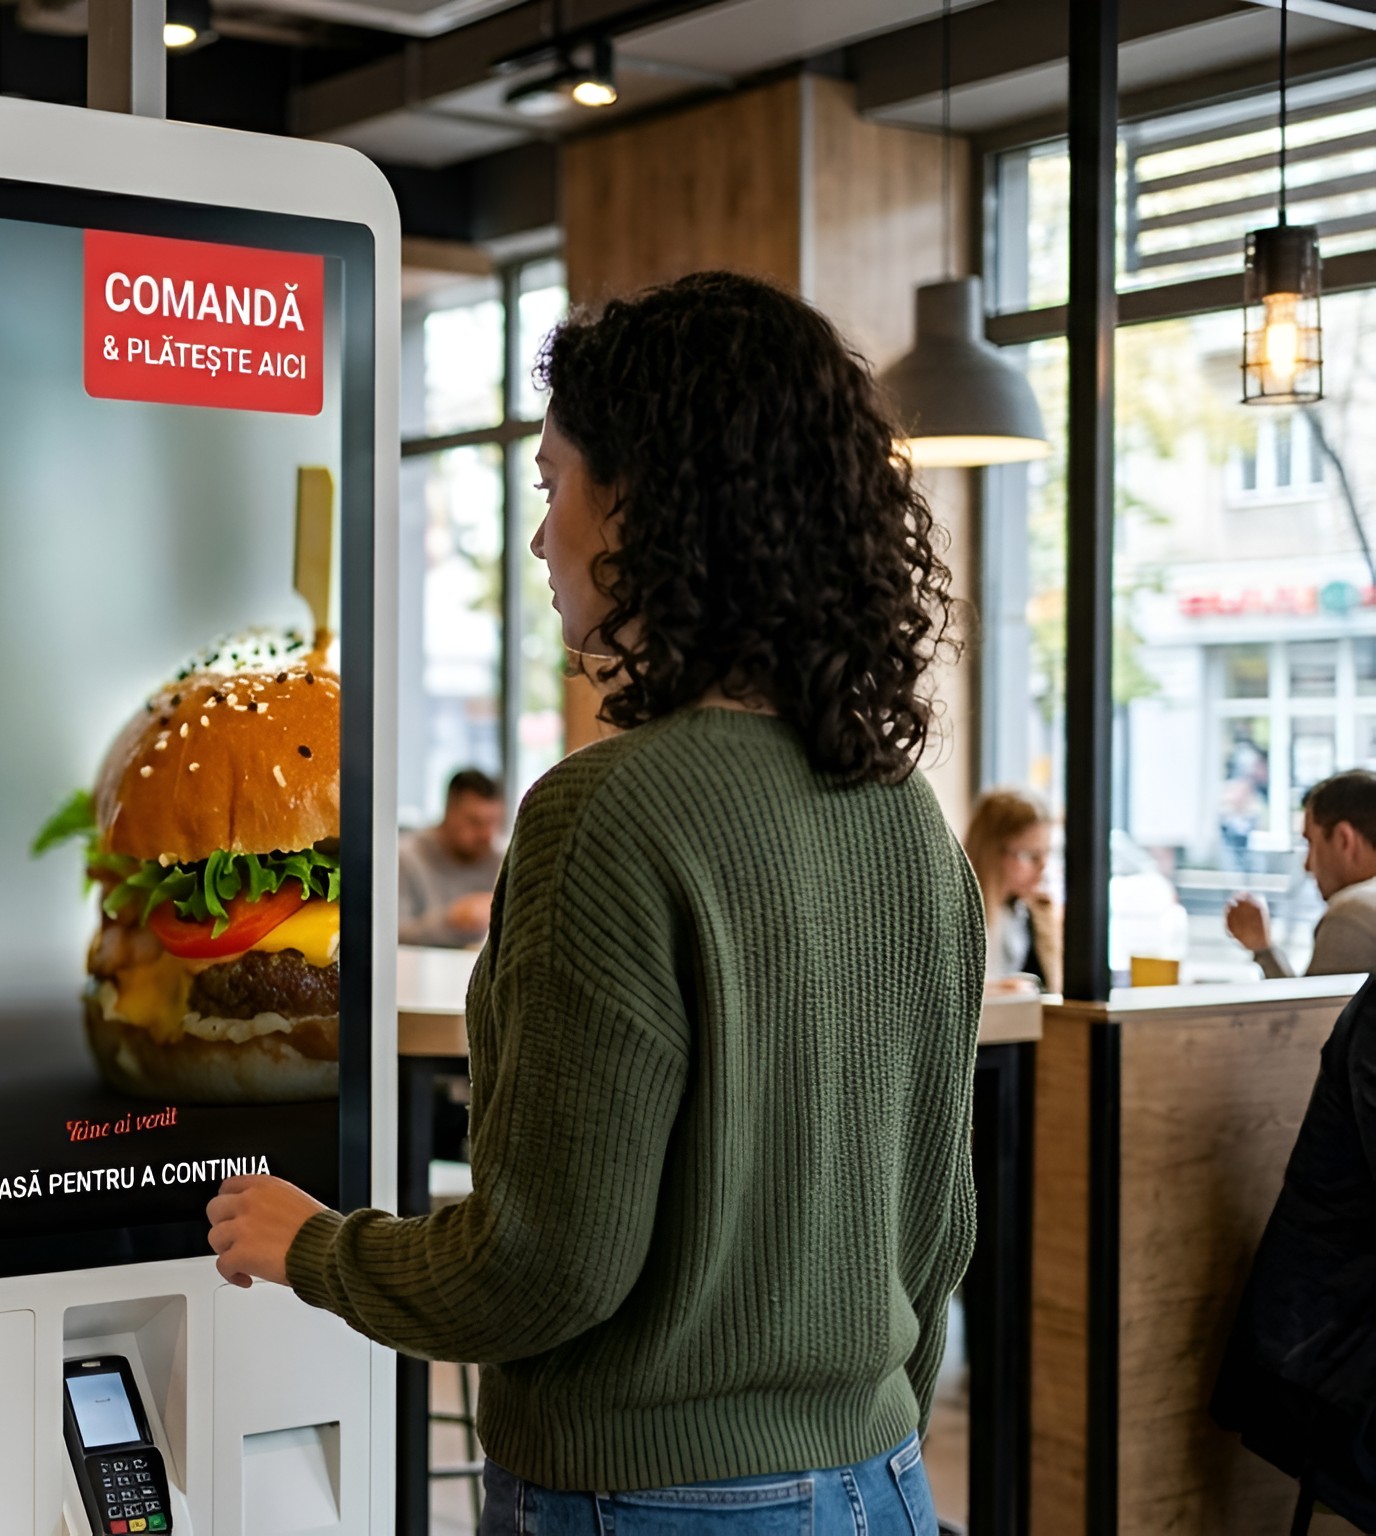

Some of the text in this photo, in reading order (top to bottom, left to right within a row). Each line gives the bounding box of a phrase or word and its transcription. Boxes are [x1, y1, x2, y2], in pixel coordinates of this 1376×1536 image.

[105, 271, 305, 332] COMANDĂ
[103, 334, 306, 379] & PLĂTEȘTE AICI
[114, 1113, 131, 1134] ai
[49, 1166, 135, 1195] PENTRU
[140, 1165, 156, 1187] A
[161, 1155, 271, 1185] CONTINUA
